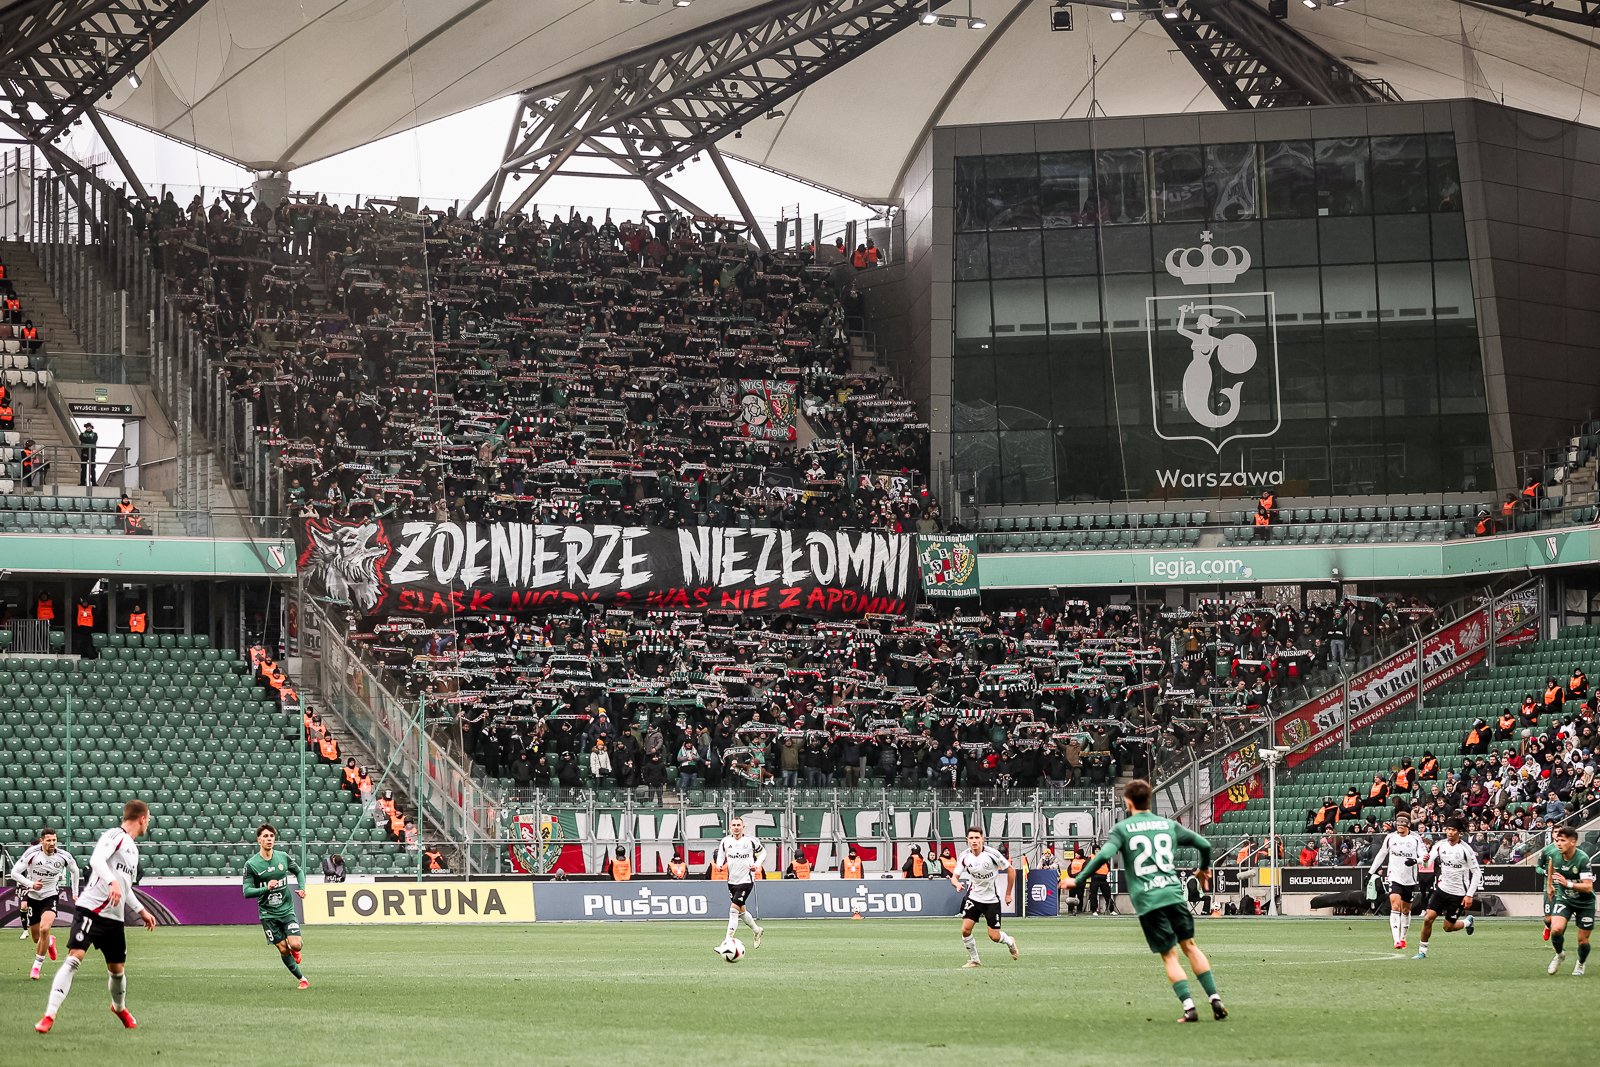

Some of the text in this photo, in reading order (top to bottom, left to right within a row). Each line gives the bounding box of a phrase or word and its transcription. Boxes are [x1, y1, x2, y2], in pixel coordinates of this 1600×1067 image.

[748, 425, 789, 437] ON TOUR
[1155, 469, 1283, 488] Warszawa
[945, 534, 974, 543] FRONTACH
[386, 521, 912, 599] ŻOŁNIERZE NIEZŁOMNI
[1150, 557, 1243, 579] legia.com
[721, 586, 770, 610] NIE
[1314, 737, 1335, 751] ZNAK
[1423, 670, 1455, 692] ROWADZI
[1129, 833, 1175, 877] 28
[1289, 876, 1353, 885] SKLEP.LEGIA.COM
[326, 885, 922, 917] FORTUNA Plus500 Plus500
[1553, 903, 1567, 913] 17
[81, 916, 93, 933] 11
